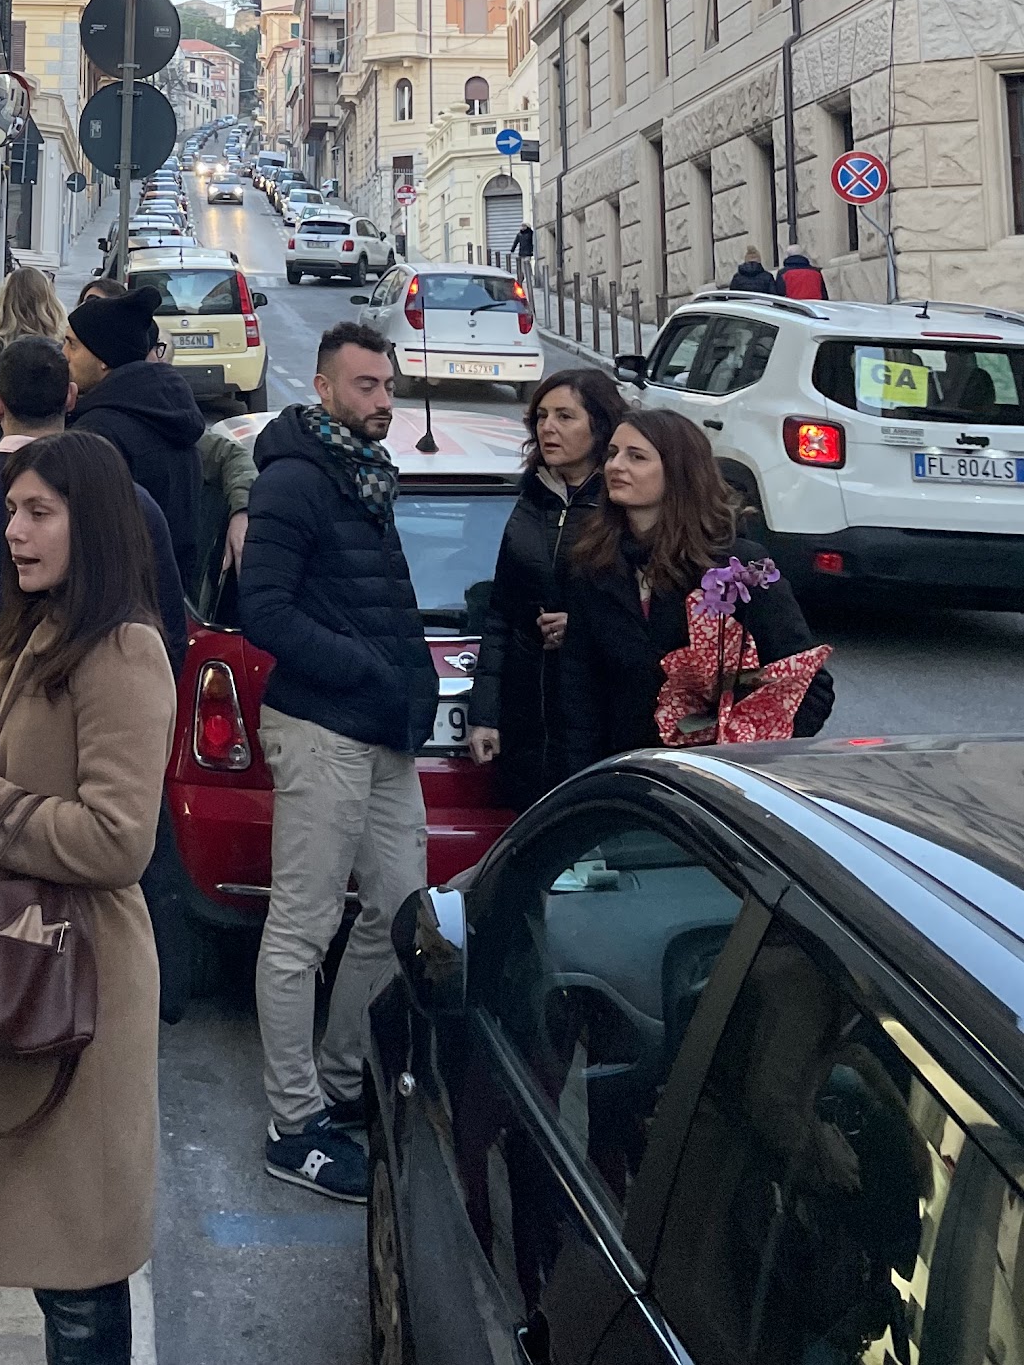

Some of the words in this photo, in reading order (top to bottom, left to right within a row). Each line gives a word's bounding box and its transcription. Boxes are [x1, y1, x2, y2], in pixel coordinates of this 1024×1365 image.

[870, 363, 917, 390] GA
[956, 433, 990, 448] Jeep
[928, 457, 950, 475] FL
[957, 459, 1014, 479] 804LS
